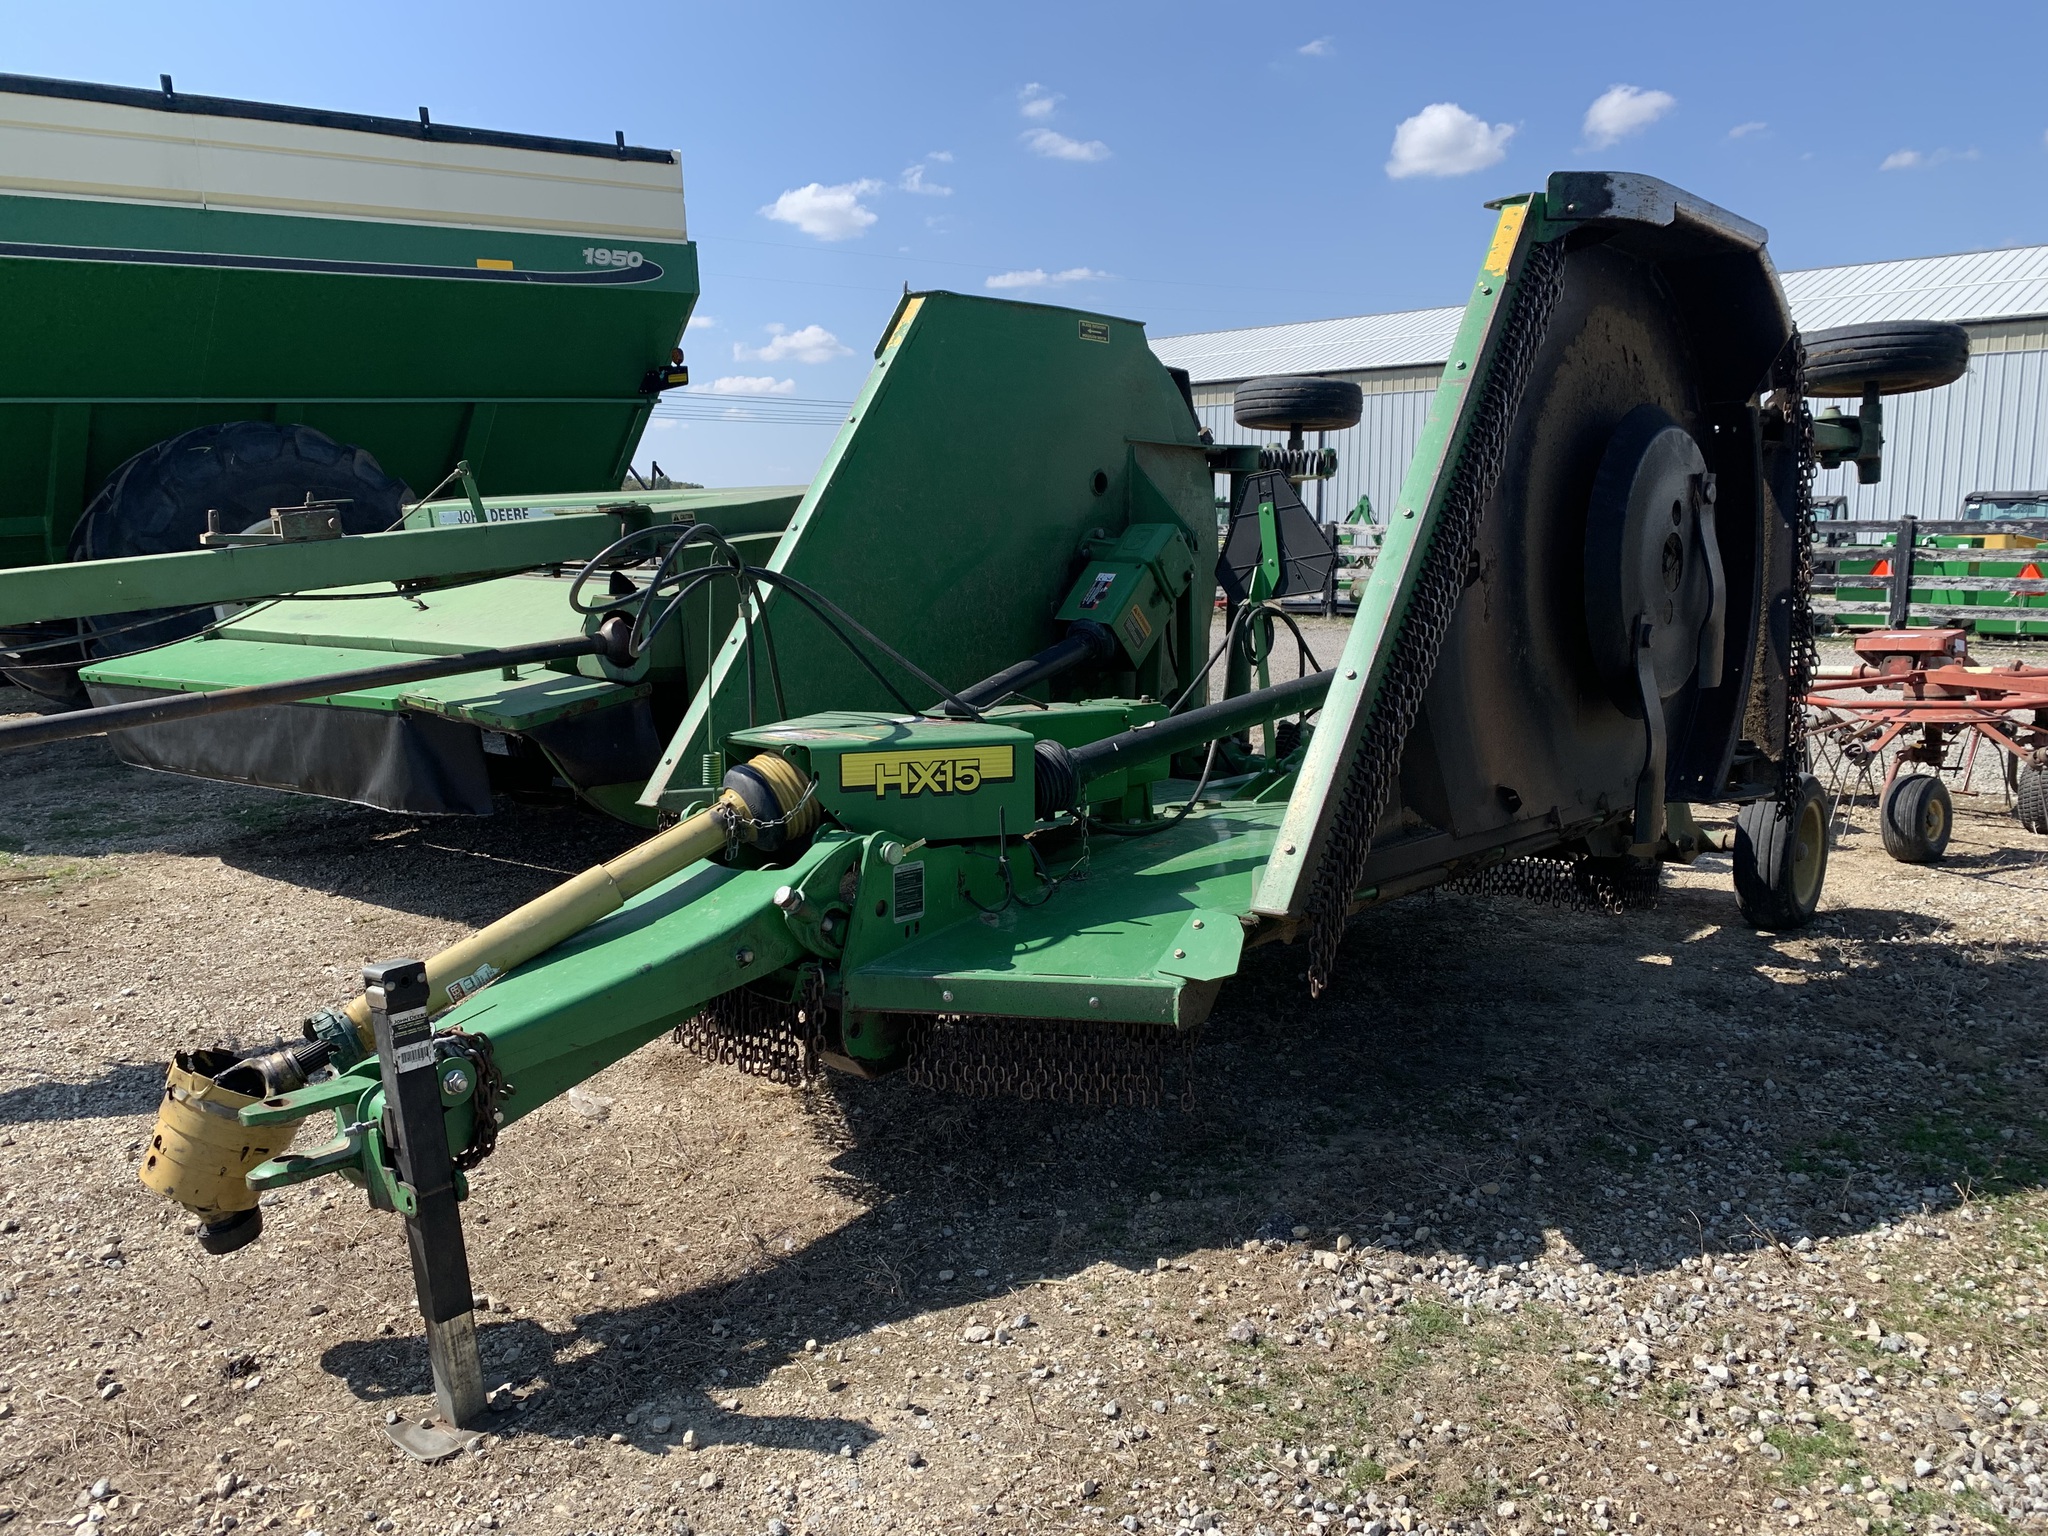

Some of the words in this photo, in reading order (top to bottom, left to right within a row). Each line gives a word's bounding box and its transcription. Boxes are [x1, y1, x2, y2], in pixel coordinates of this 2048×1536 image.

[582, 247, 644, 268] 1950
[489, 507, 530, 522] DEERE
[875, 758, 982, 797] HX15
